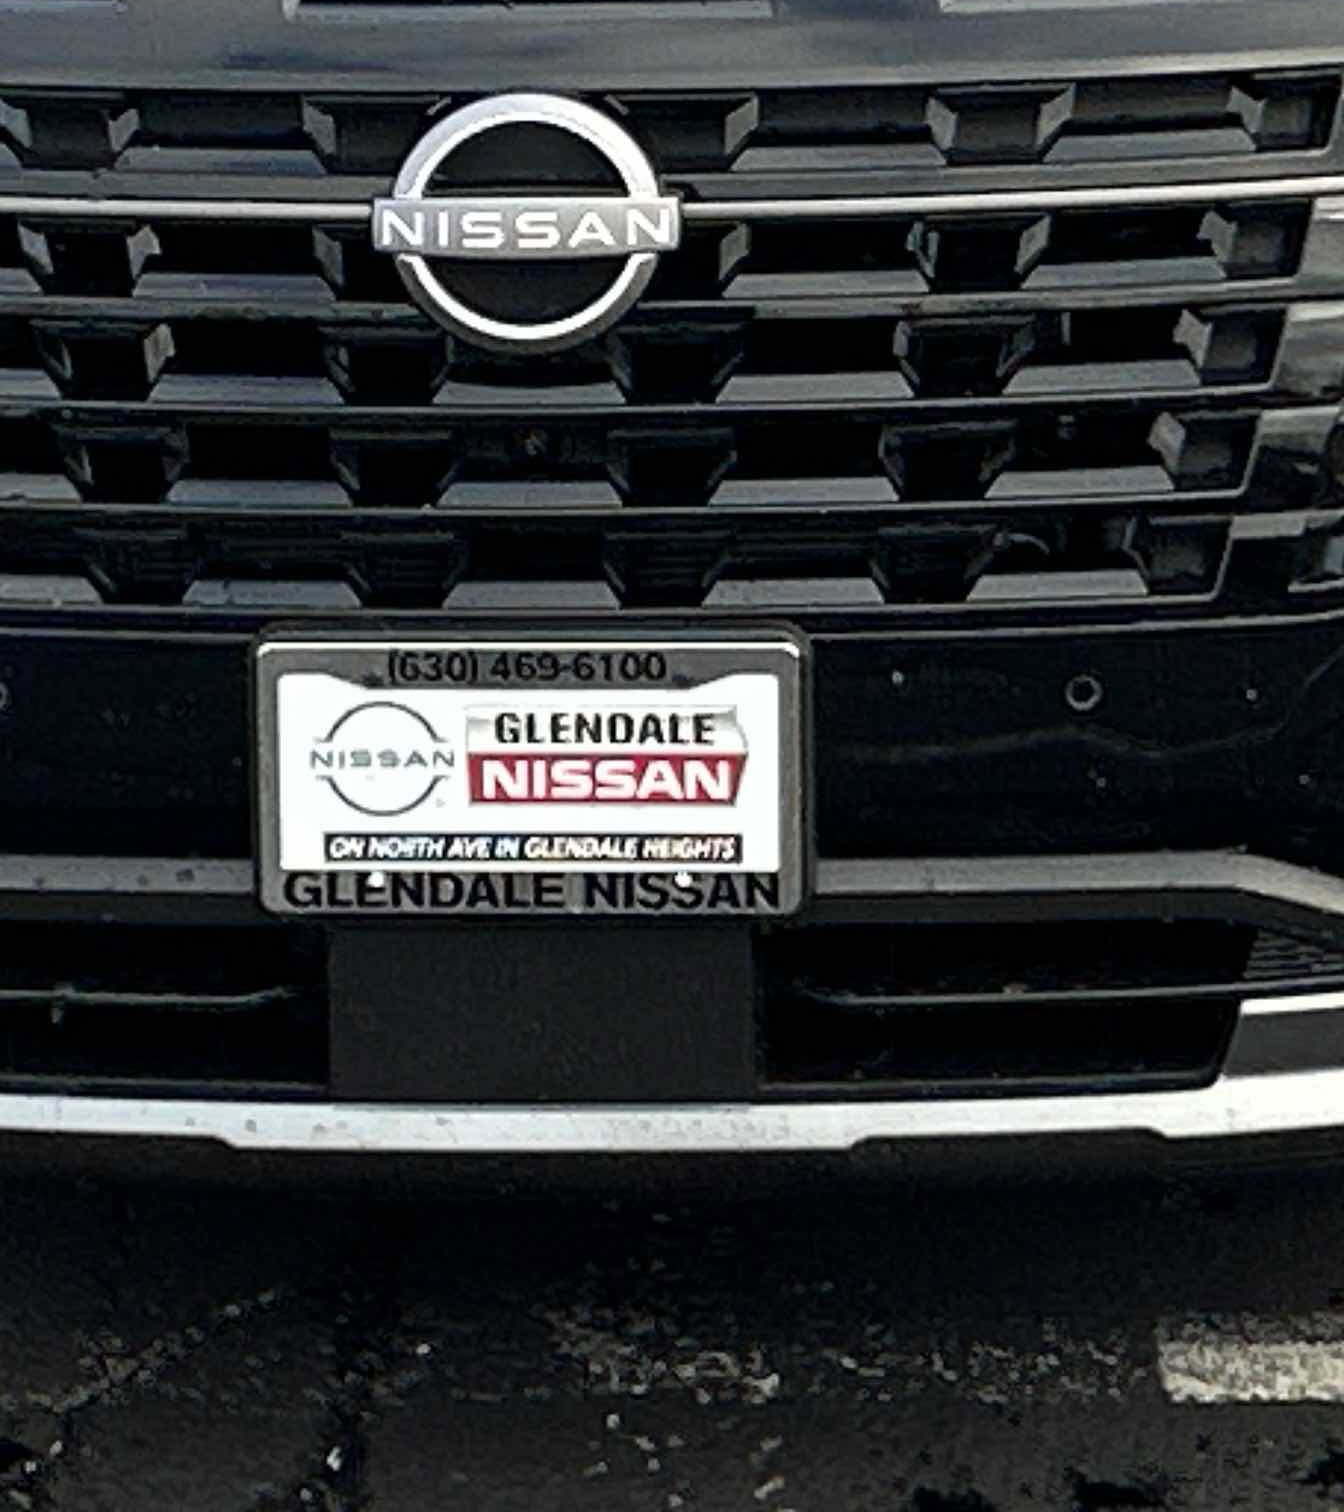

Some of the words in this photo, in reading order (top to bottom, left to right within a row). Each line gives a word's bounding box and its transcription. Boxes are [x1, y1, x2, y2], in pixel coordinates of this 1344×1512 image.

[380, 206, 670, 250] NISSAN
[387, 649, 479, 685] (630)
[490, 651, 667, 682] 469-6100
[494, 711, 715, 745] GLENDALE
[309, 750, 455, 769] NISSAN
[481, 759, 730, 800] NISSAN
[329, 836, 365, 859] ON
[367, 836, 445, 859] NORTH
[447, 836, 492, 859] AVE
[494, 836, 520, 859] IN
[523, 836, 638, 860] GLENDALE
[641, 836, 735, 860] HEIGHTS
[283, 871, 564, 909] GLENDALE
[584, 871, 780, 909] NISSAN
